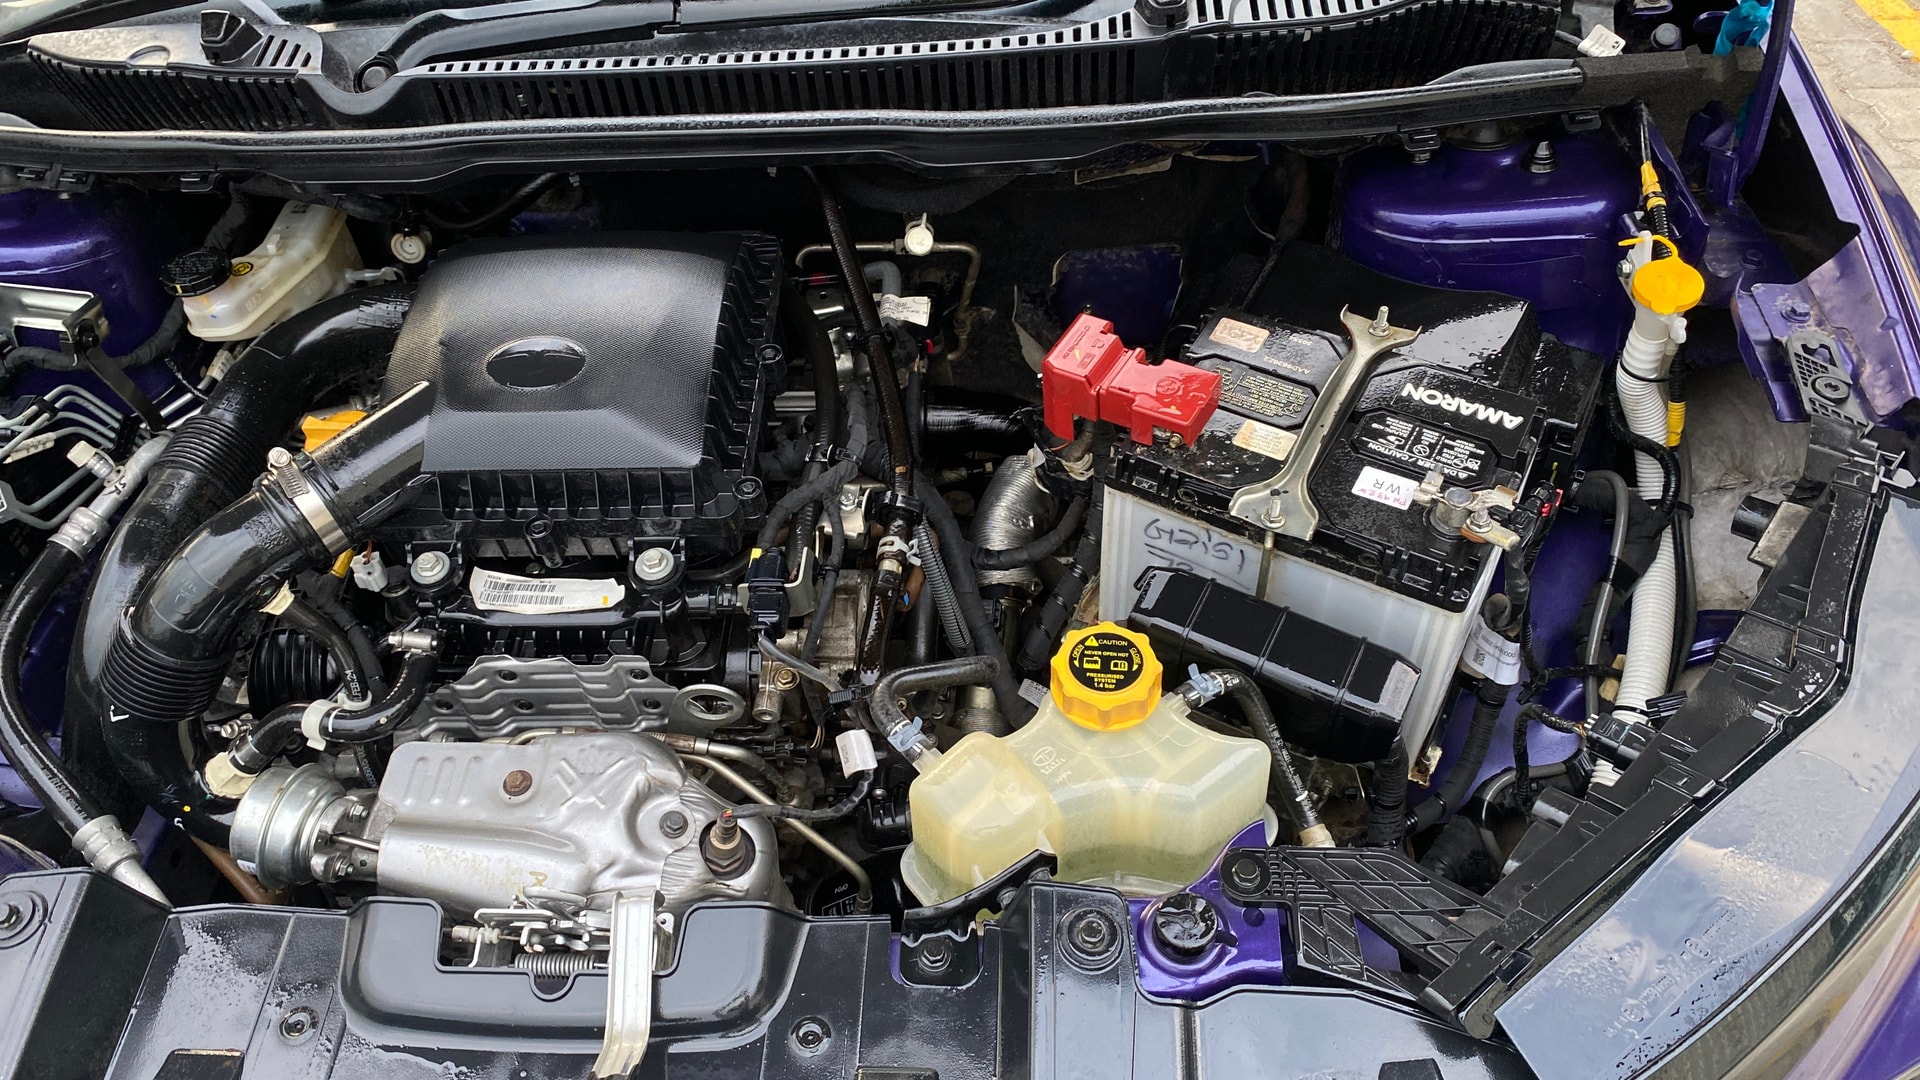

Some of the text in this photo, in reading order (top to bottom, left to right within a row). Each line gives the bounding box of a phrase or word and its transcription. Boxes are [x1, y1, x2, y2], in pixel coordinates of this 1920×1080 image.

[1400, 382, 1525, 430] AMARON
[1367, 442, 1410, 462] CAUTION
[1416, 459, 1458, 476] DAER
[1072, 644, 1085, 658] OPEN
[1098, 639, 1128, 647] CAUTION
[1131, 647, 1142, 665] CLOSE
[1086, 672, 1125, 680] PRESSURISED
